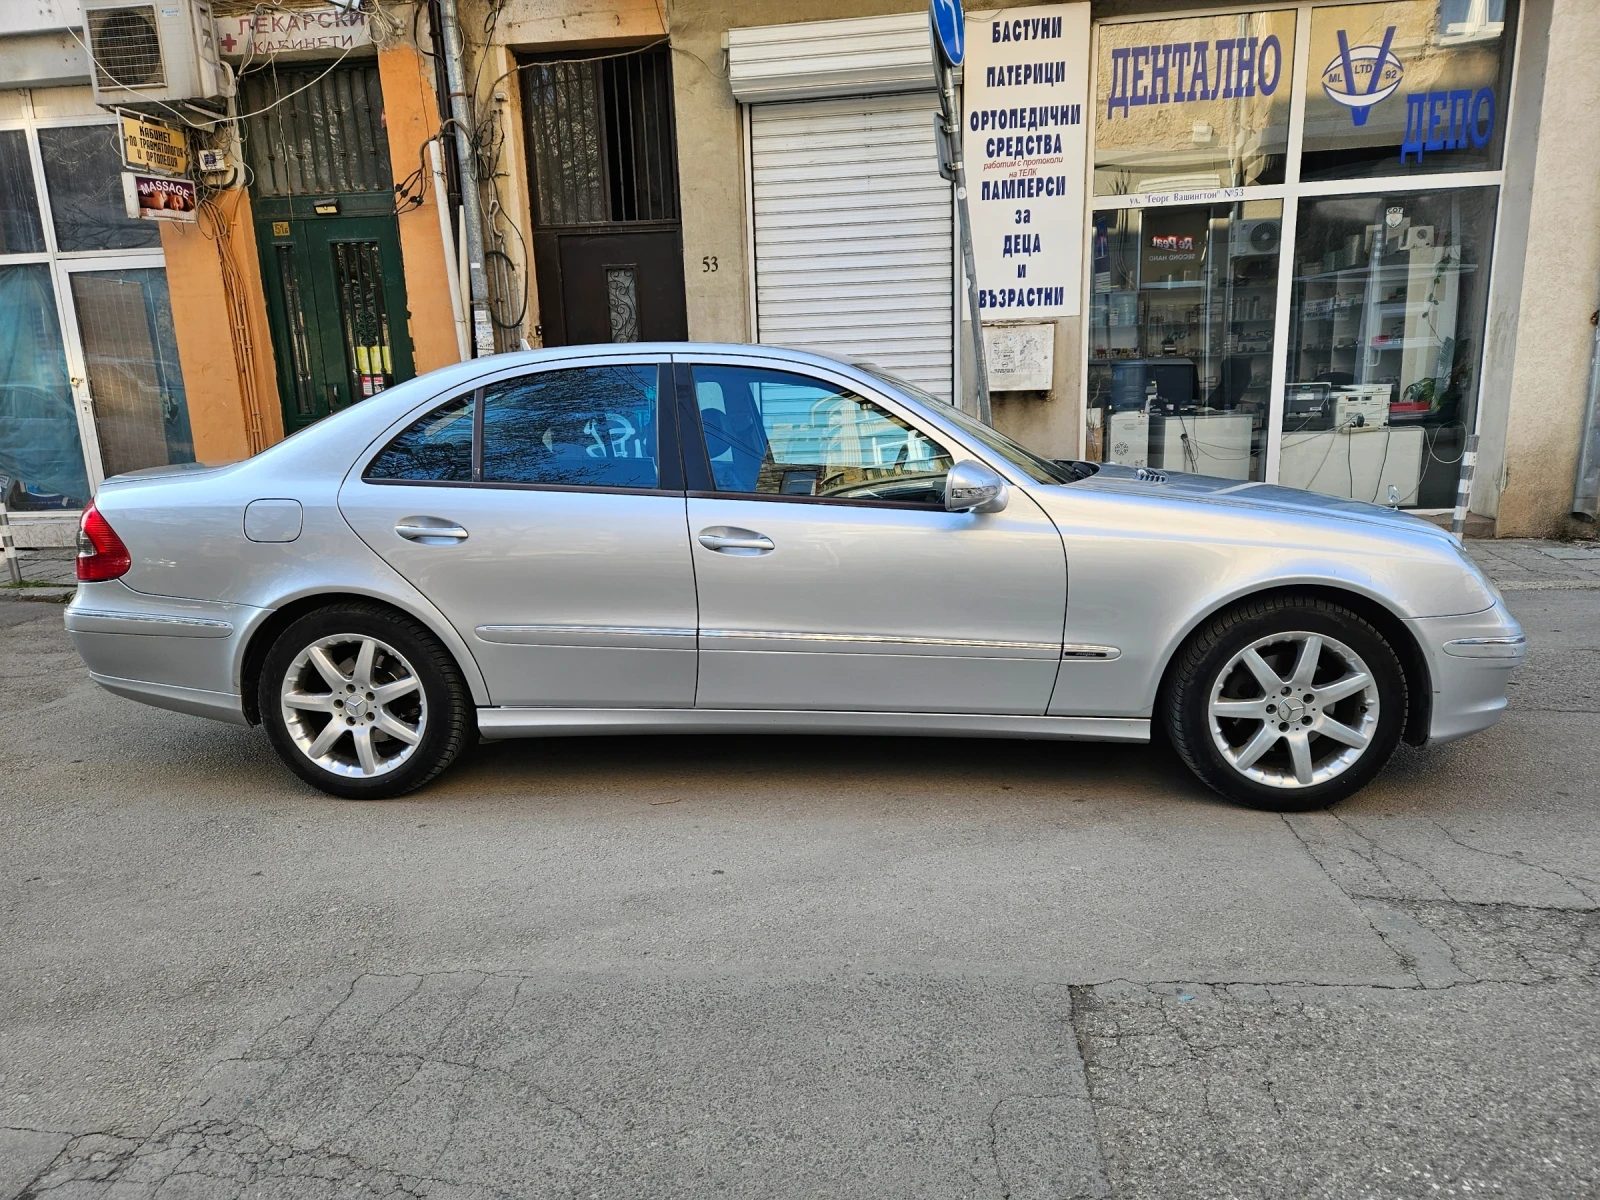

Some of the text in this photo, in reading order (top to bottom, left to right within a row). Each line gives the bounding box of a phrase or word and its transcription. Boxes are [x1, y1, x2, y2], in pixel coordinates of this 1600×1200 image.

[238, 10, 365, 36] ЛЕКАРСКИ
[992, 16, 1063, 43] БАСТУНИ
[254, 35, 353, 54] КАБИНЕТИ
[986, 61, 1066, 88] ПАТЕРИЦИ
[1108, 34, 1282, 120] ДЕНТАЛНО
[1328, 64, 1397, 83] ML LTD 92
[970, 104, 1081, 132] ОРТОПЕДИЧНИ
[1401, 86, 1496, 164] ДЕПО
[139, 126, 171, 143] КАБИНЕТ
[129, 135, 184, 158] ПО ТРАВМАТОЛОГИЯ
[986, 133, 1063, 160] СРЕДСТВА
[146, 151, 178, 168] ОРТОПЕДИЯ
[983, 160, 1016, 171] работим
[1022, 156, 1064, 169] протоколи
[1019, 168, 1038, 177] ТЕЛК
[140, 181, 190, 200] MASSAGE
[981, 175, 1066, 201] ПАМПЕРСИ
[1130, 198, 1141, 207] ул.
[1145, 194, 1169, 205] "Георг
[1173, 190, 1220, 202] Вашингтон"
[1015, 209, 1031, 224] за
[1003, 232, 1041, 258] ДЕЦА
[702, 256, 718, 272] 53
[979, 286, 1064, 309] ВЪЗРАСТНИ
